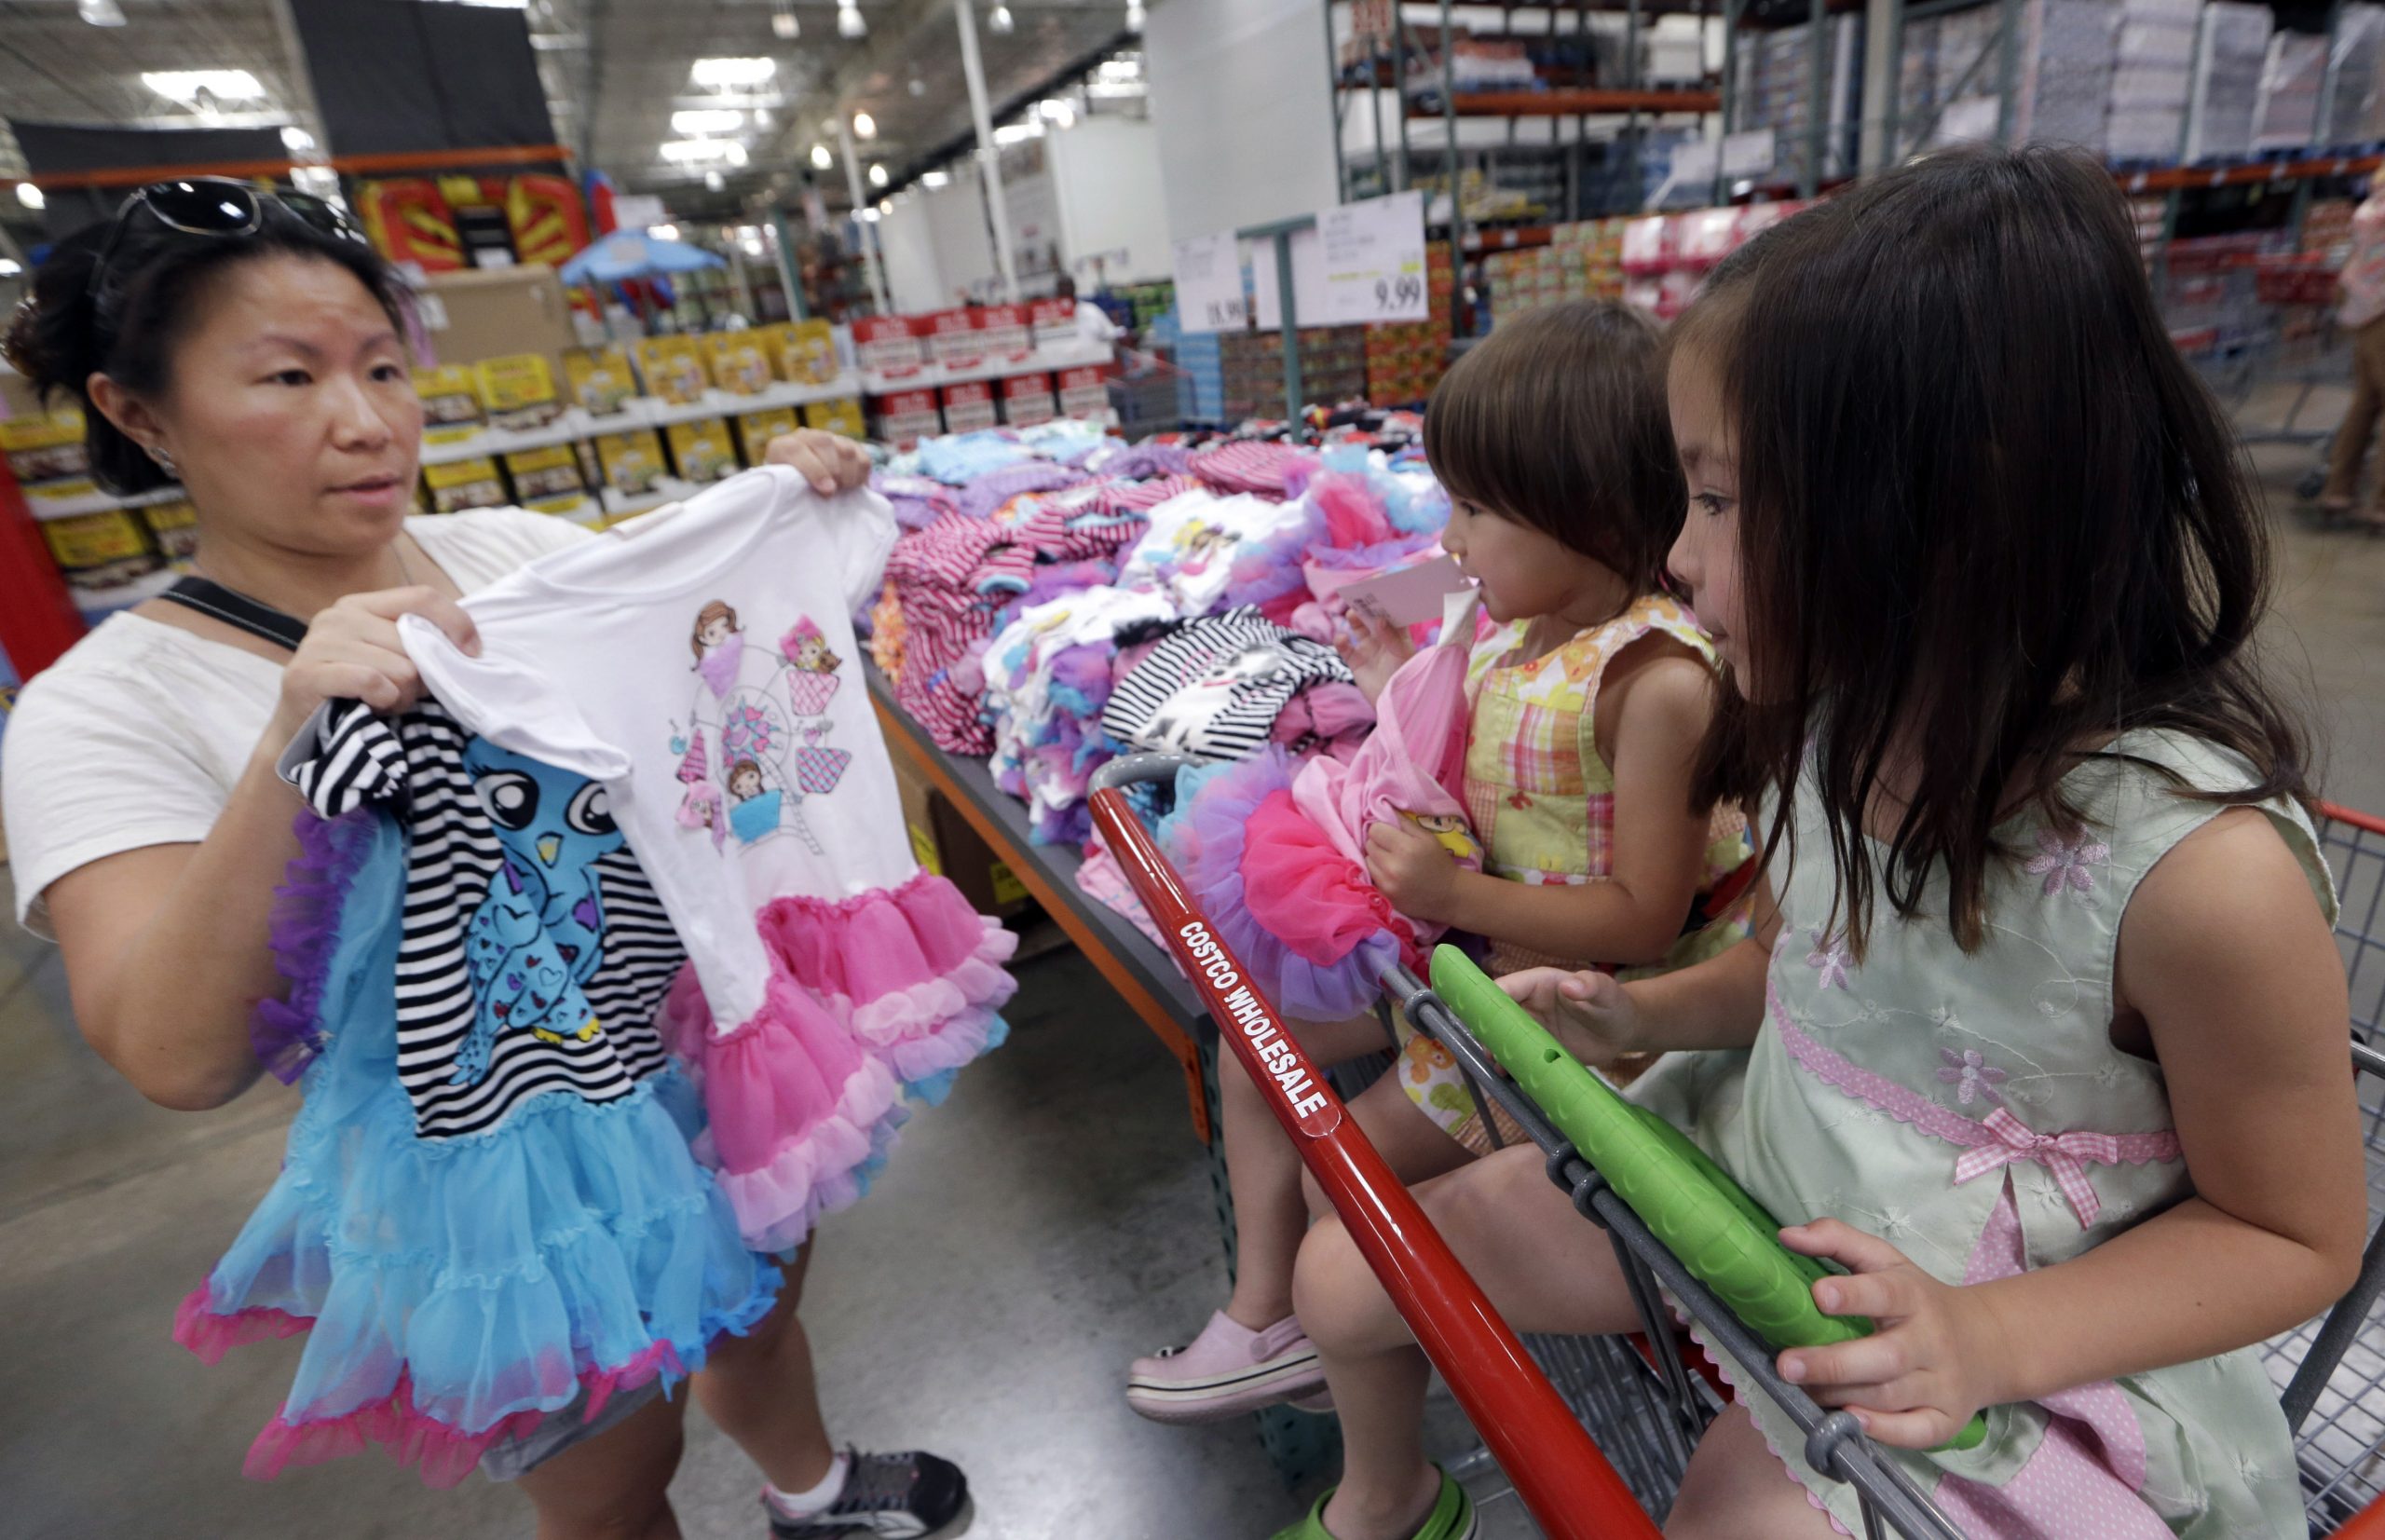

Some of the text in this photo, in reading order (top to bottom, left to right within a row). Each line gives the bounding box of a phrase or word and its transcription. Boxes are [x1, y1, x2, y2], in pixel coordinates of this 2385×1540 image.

[1374, 276, 1421, 311] 9.99
[1179, 921, 1328, 1119] COSTCO WHOLESALE
